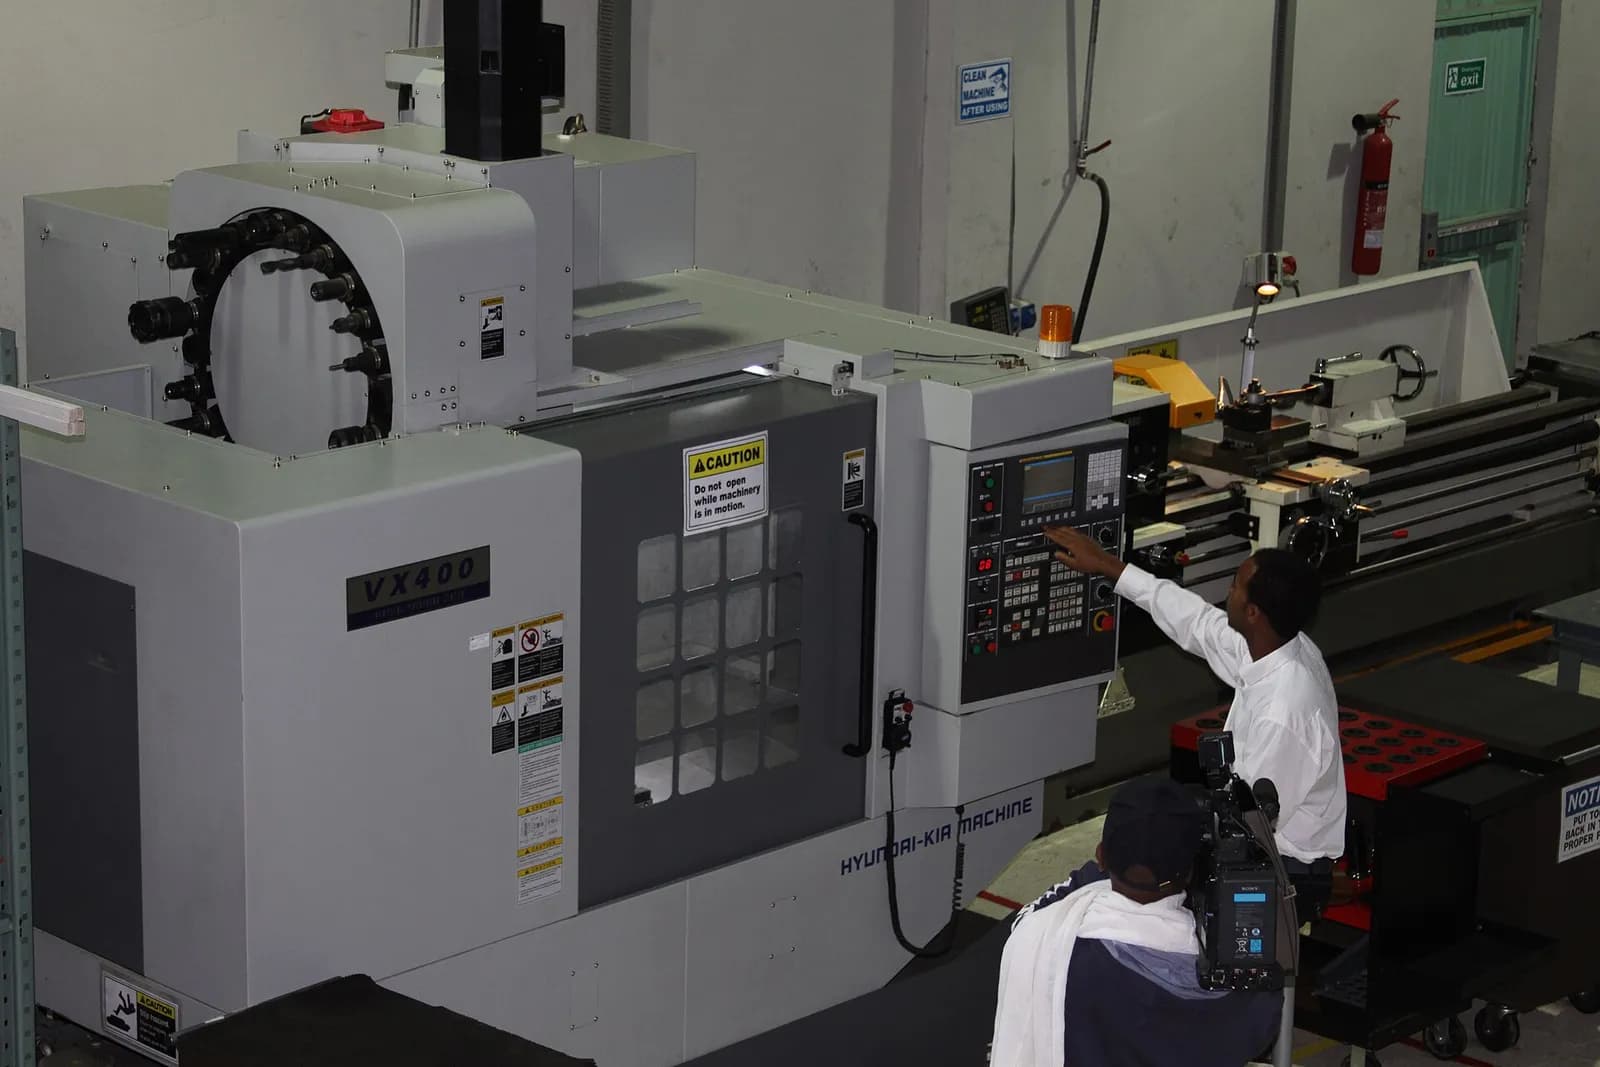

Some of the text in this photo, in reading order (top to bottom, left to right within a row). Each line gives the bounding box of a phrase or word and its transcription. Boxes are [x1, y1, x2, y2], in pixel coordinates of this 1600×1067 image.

[964, 70, 987, 83] CLEAN
[1460, 72, 1479, 87] exit
[963, 86, 995, 101] MACHINE
[962, 101, 1008, 117] AFTER USING
[706, 446, 760, 470] CAUTION
[694, 476, 746, 495] Do not open
[694, 484, 761, 507] while machinery
[694, 501, 745, 519] is in motion.
[364, 557, 475, 603] VX400
[959, 797, 1033, 834] MACHINE
[1573, 812, 1587, 825] PUT
[1565, 825, 1585, 841] BACK
[1588, 821, 1596, 833] IN
[1563, 833, 1594, 851] PROPER
